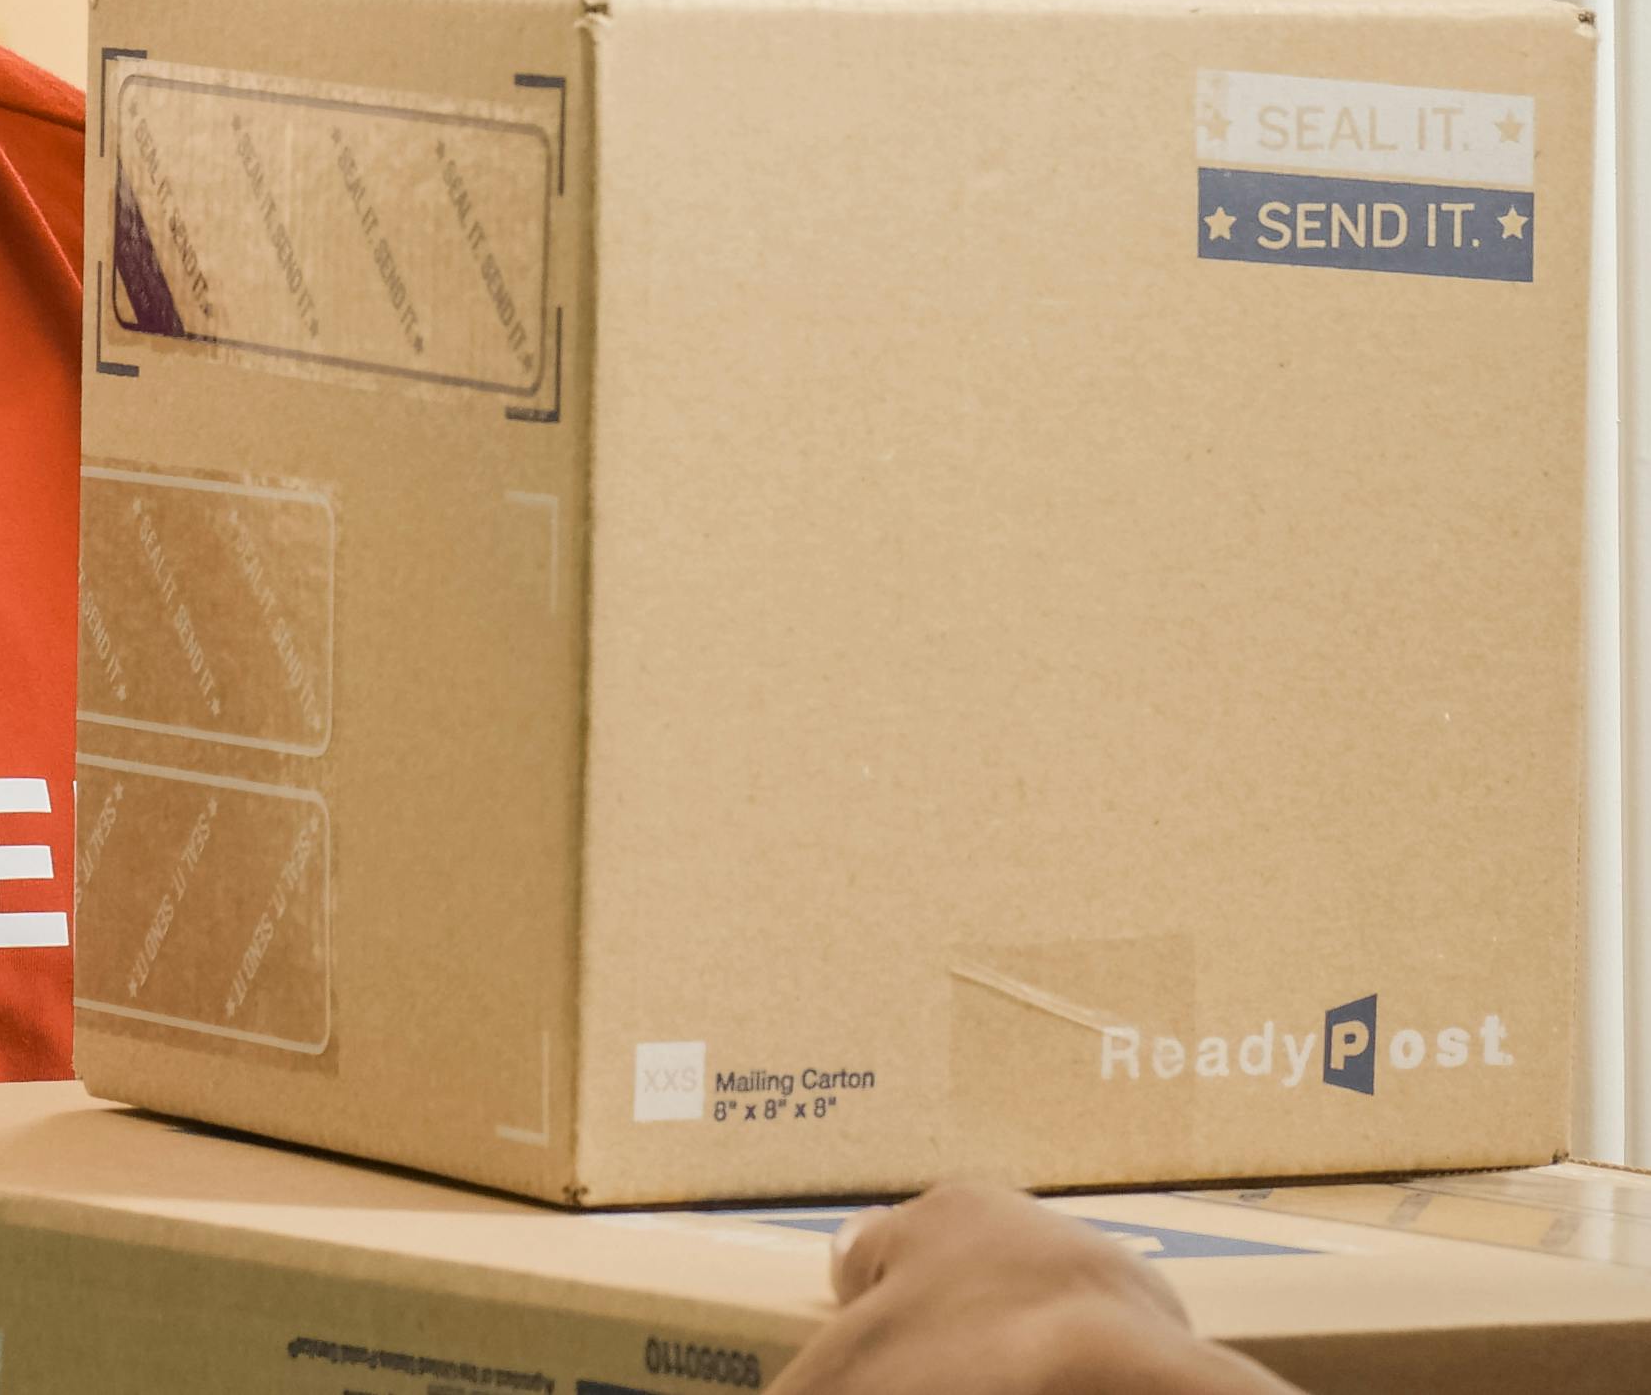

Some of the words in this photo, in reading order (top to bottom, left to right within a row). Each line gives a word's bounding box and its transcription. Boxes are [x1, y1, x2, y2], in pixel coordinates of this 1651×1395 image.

[1256, 104, 1398, 153] SEAL
[1416, 106, 1470, 153] IT.
[1256, 200, 1409, 251] SEND
[1425, 201, 1481, 249] IT.
[642, 1065, 699, 1094] XXS
[715, 1069, 794, 1096] Mailing
[802, 1068, 876, 1090] Carton
[713, 1100, 737, 1122] 8"
[744, 1105, 757, 1121] x
[763, 1098, 787, 1120] 8"
[794, 1103, 807, 1119] x
[813, 1096, 837, 1118] 8"
